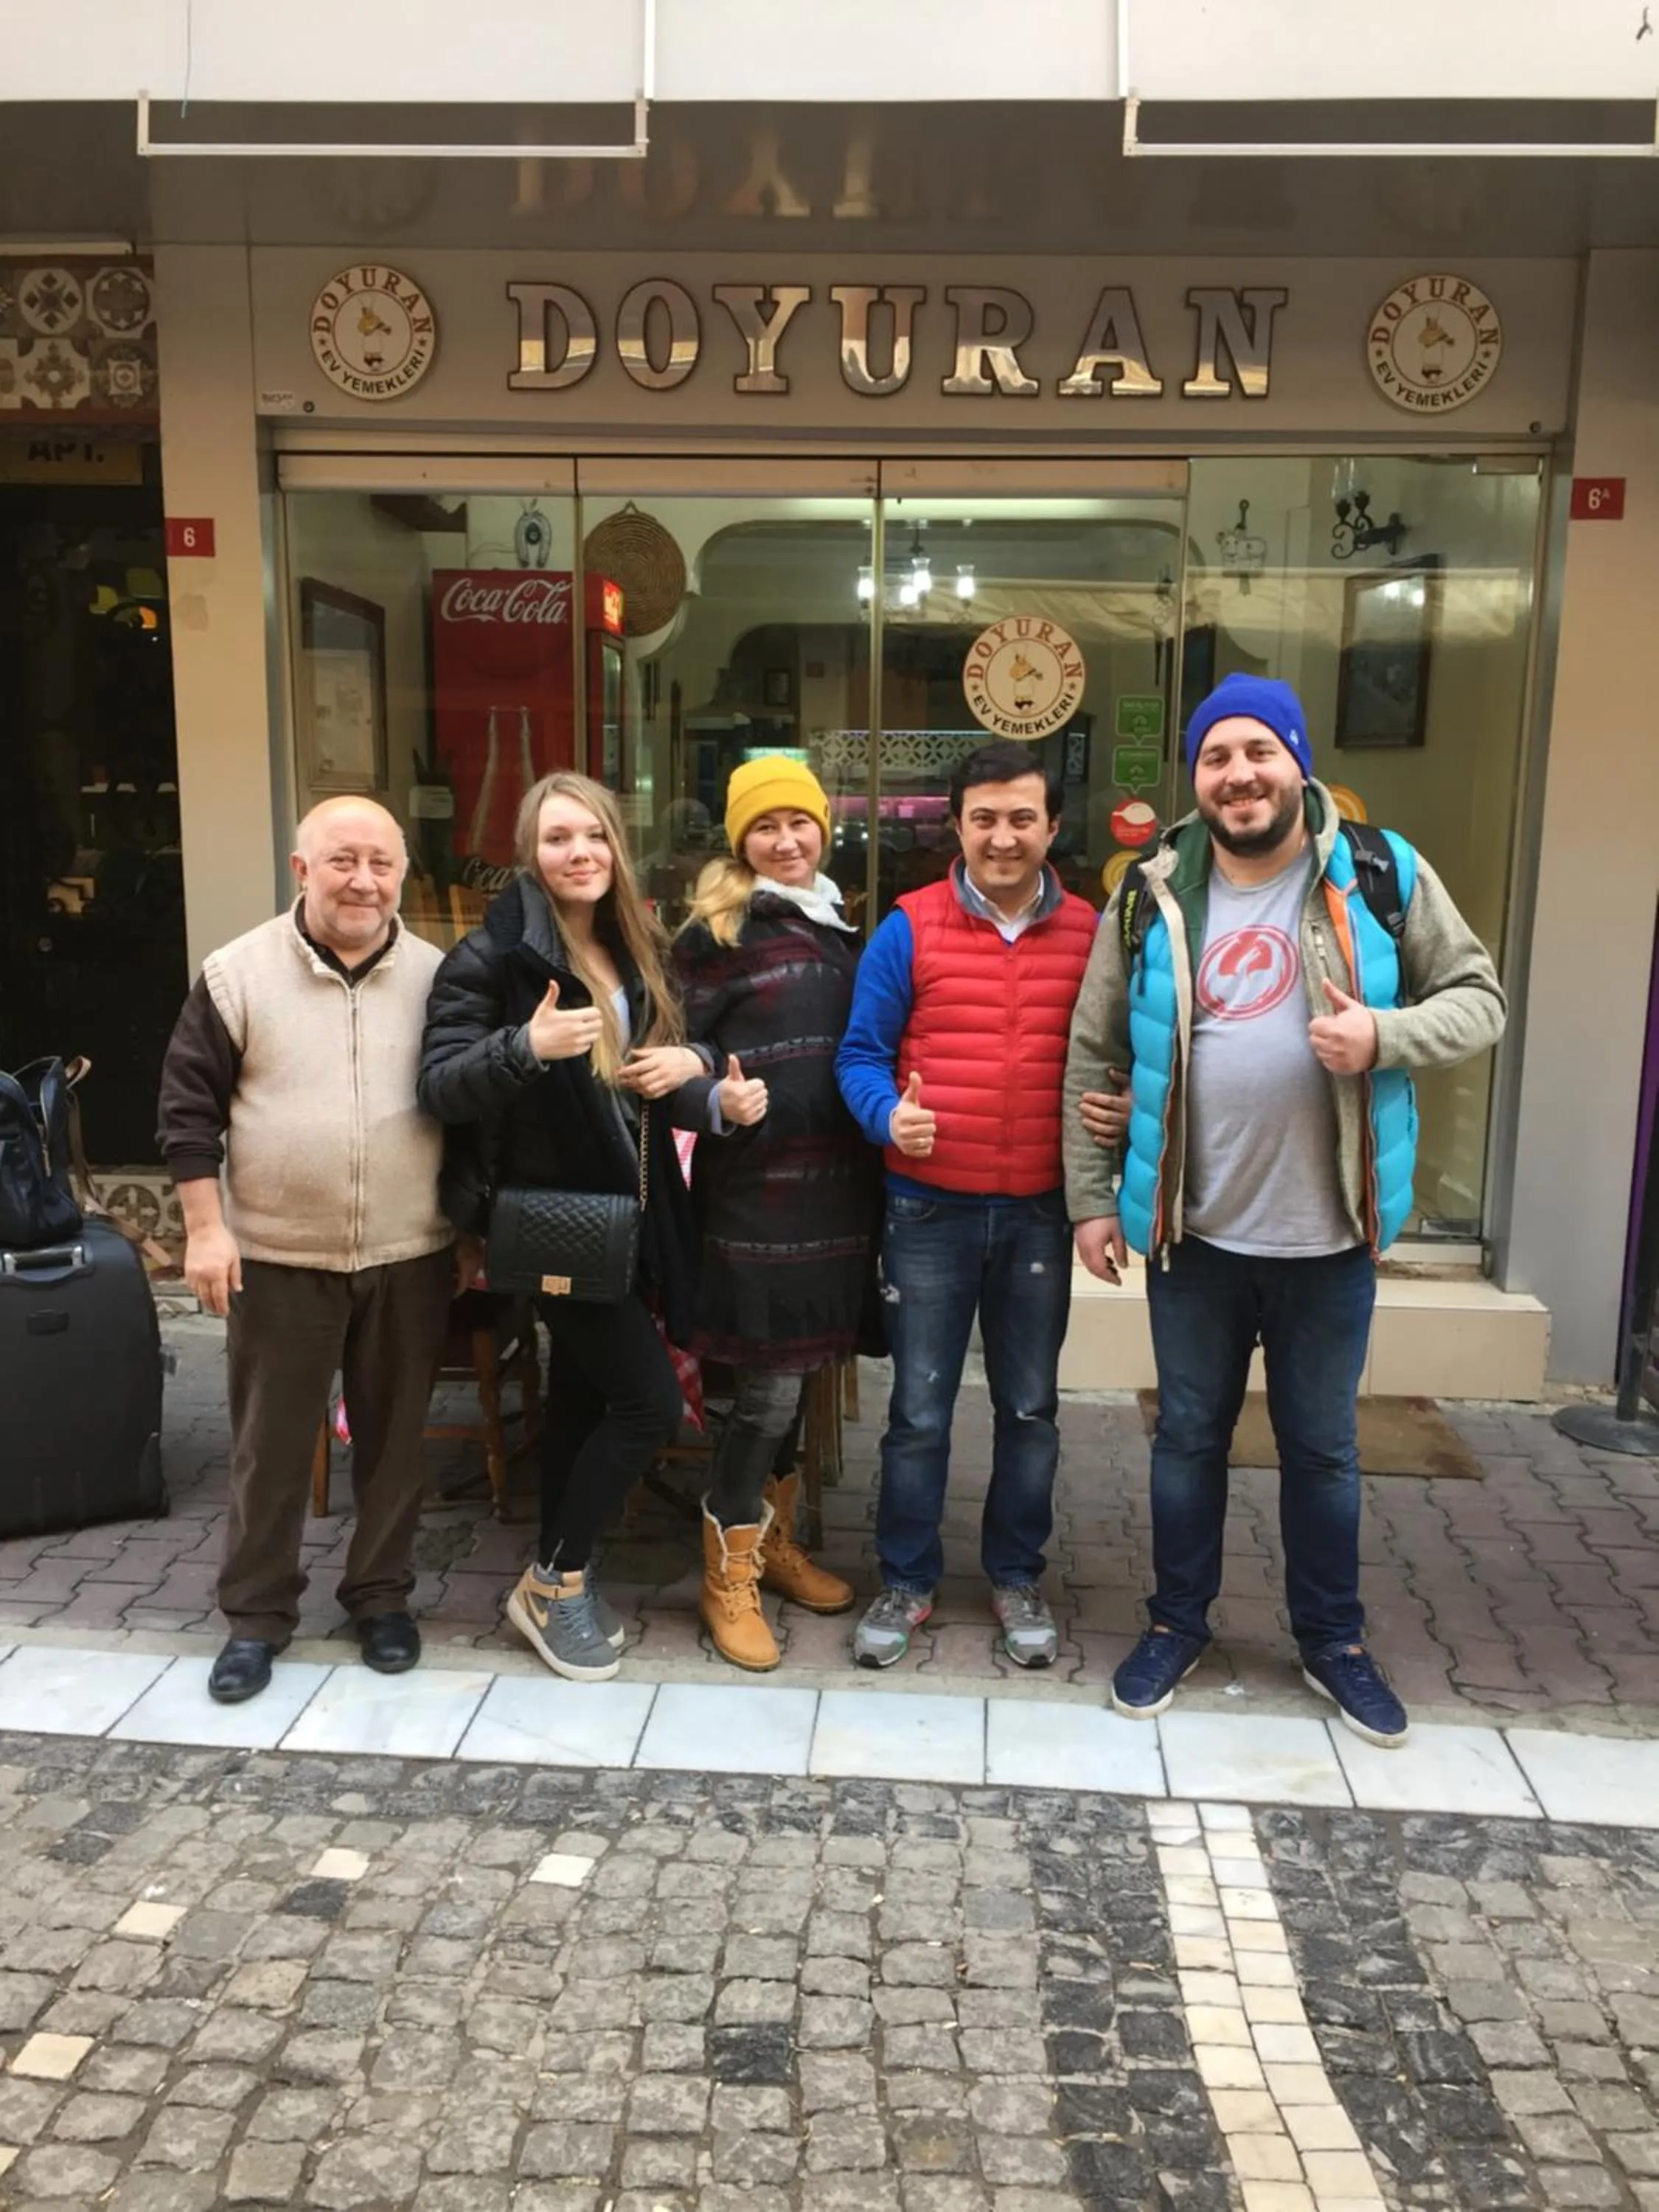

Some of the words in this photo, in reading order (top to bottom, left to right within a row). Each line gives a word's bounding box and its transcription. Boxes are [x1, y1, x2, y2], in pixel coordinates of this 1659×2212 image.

[313, 268, 432, 333] DOYURAN
[1371, 277, 1498, 345] DOYURAN
[321, 349, 341, 372] EV
[507, 277, 1289, 399] DOYURAN
[1376, 361, 1396, 384] EV
[183, 526, 195, 548] 6
[441, 577, 573, 624] Coca-Cola
[967, 619, 1083, 681] DOYURAN
[973, 695, 991, 716] EV
